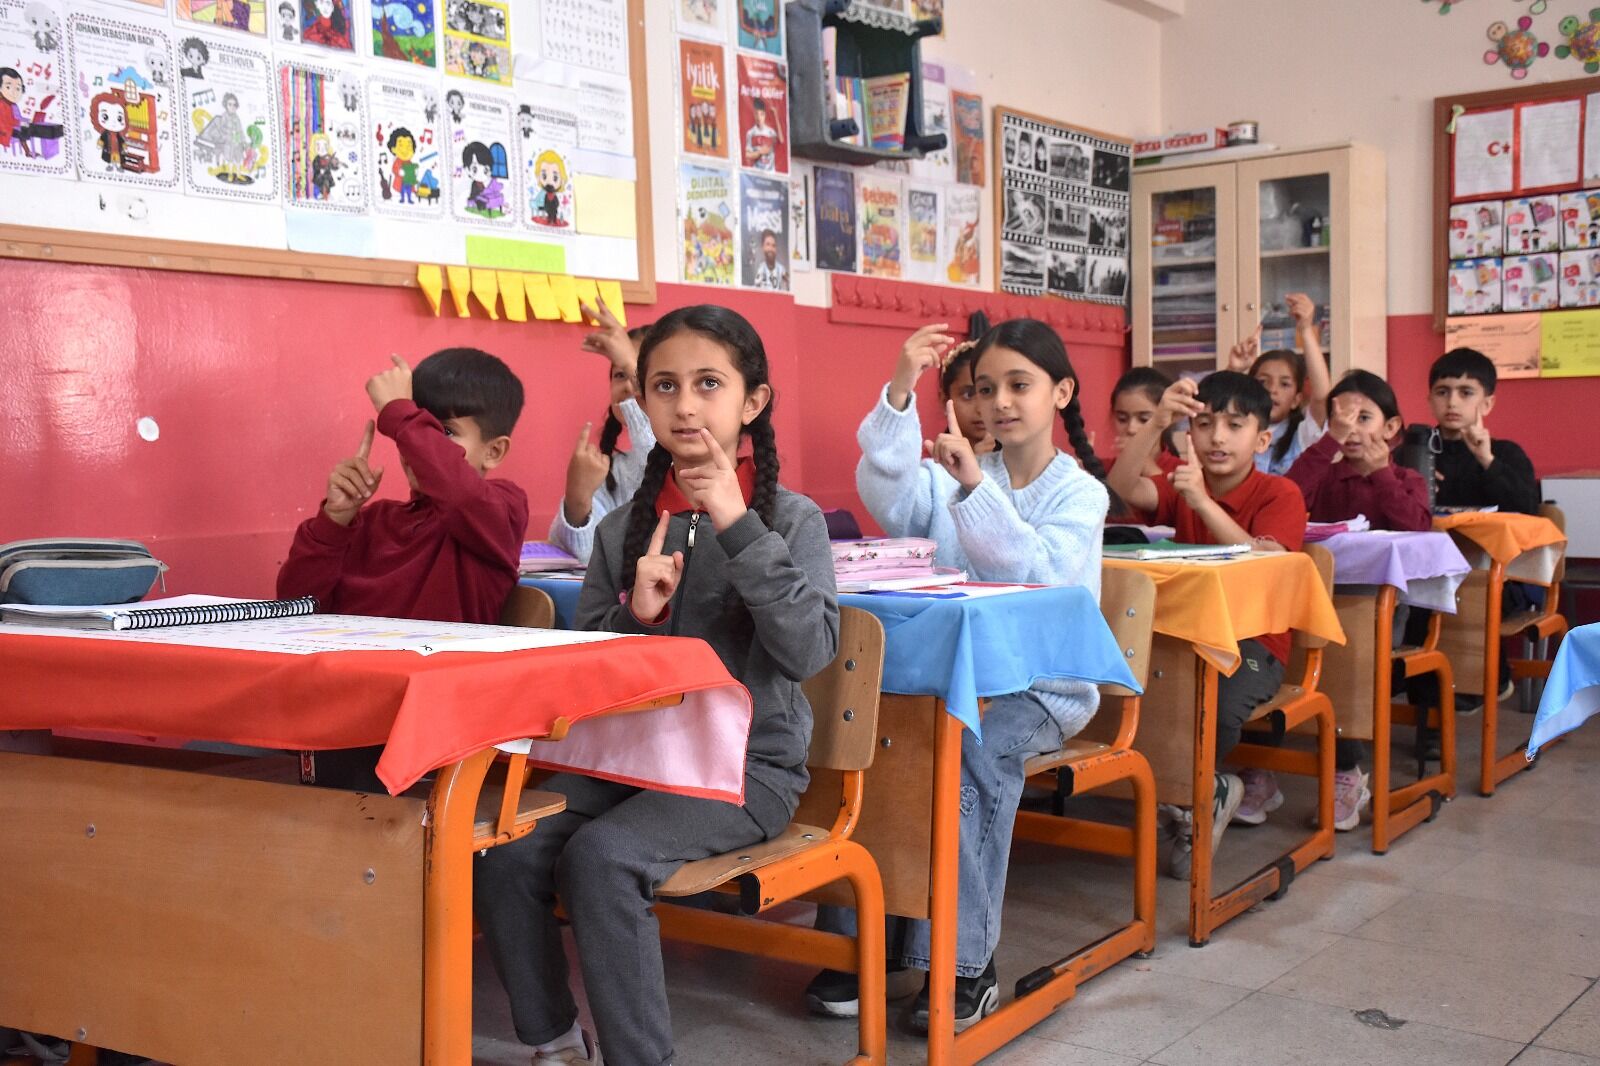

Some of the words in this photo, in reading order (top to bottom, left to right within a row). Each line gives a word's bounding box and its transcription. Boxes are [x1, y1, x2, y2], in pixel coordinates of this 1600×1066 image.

[75, 22, 101, 36] JOHANN
[101, 27, 137, 43] SEBASTIAN
[137, 33, 155, 46] BACH
[219, 52, 255, 69] BEETHOVEN
